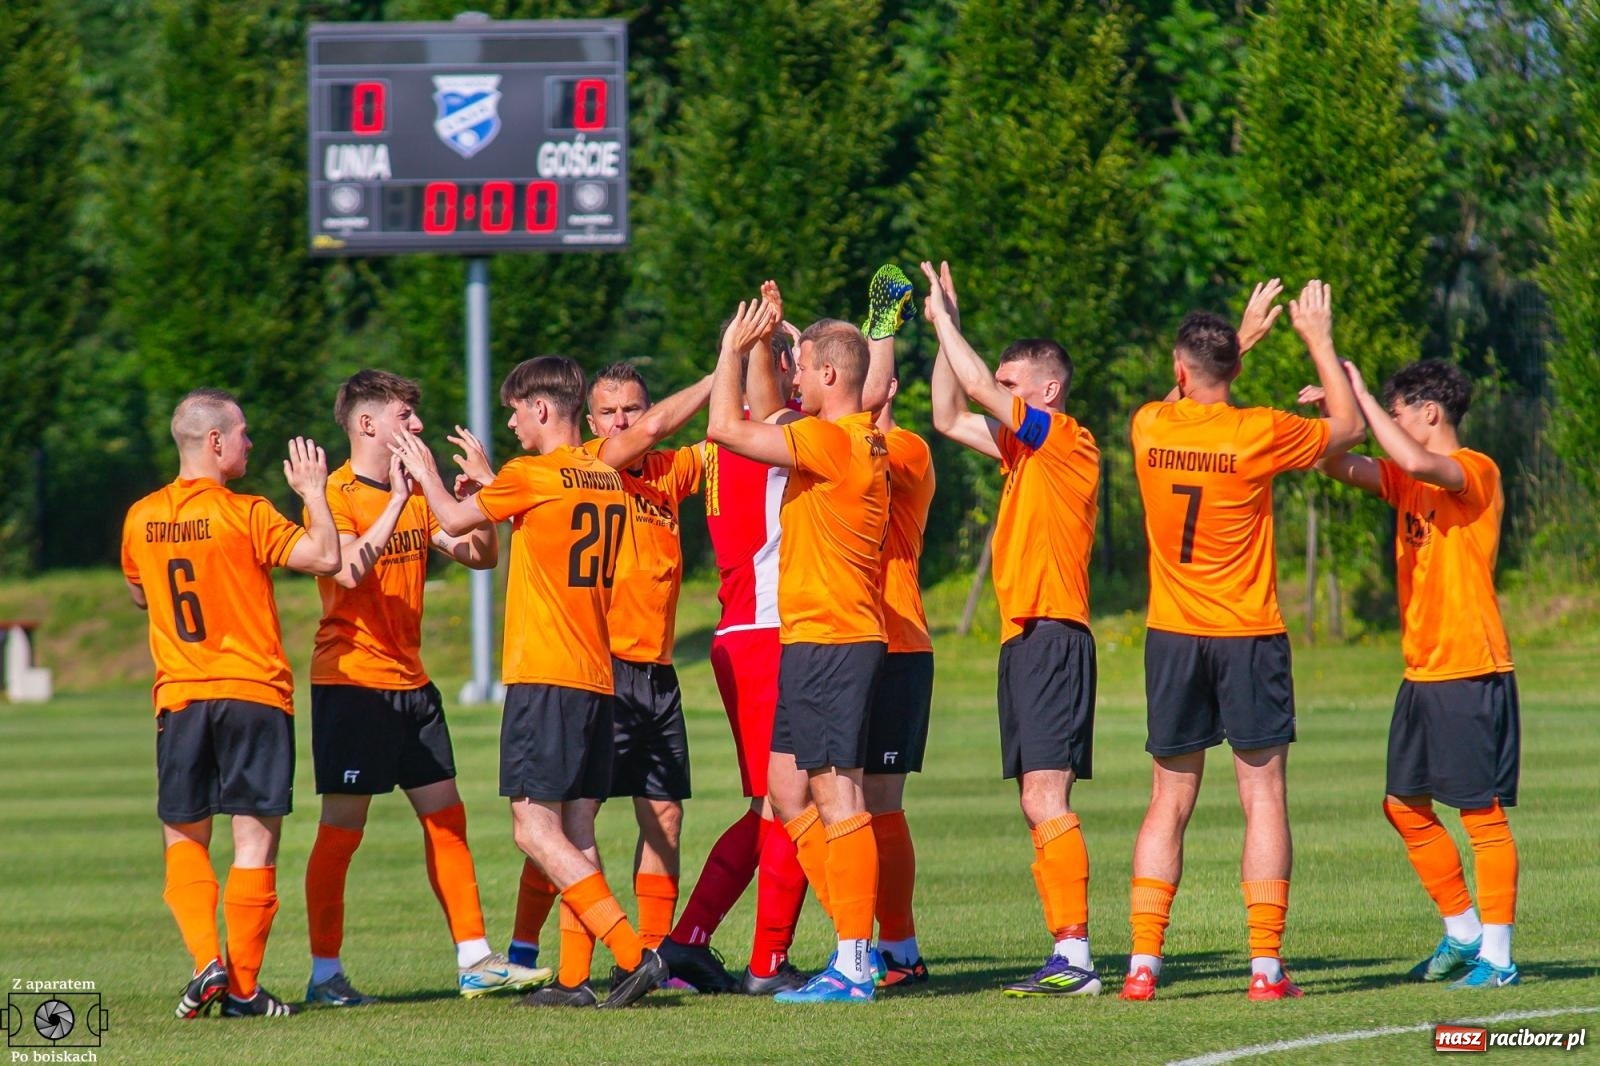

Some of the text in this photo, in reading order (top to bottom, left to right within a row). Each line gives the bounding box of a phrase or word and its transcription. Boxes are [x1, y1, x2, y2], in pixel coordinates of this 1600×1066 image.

[351, 81, 387, 135] 0
[573, 77, 608, 132] 0
[324, 143, 392, 181] UNIA
[536, 134, 621, 178] GOŚCIE
[1148, 447, 1238, 474] STANOWICE
[568, 502, 627, 589] 20
[1172, 484, 1203, 563] 7
[167, 558, 207, 643] 6
